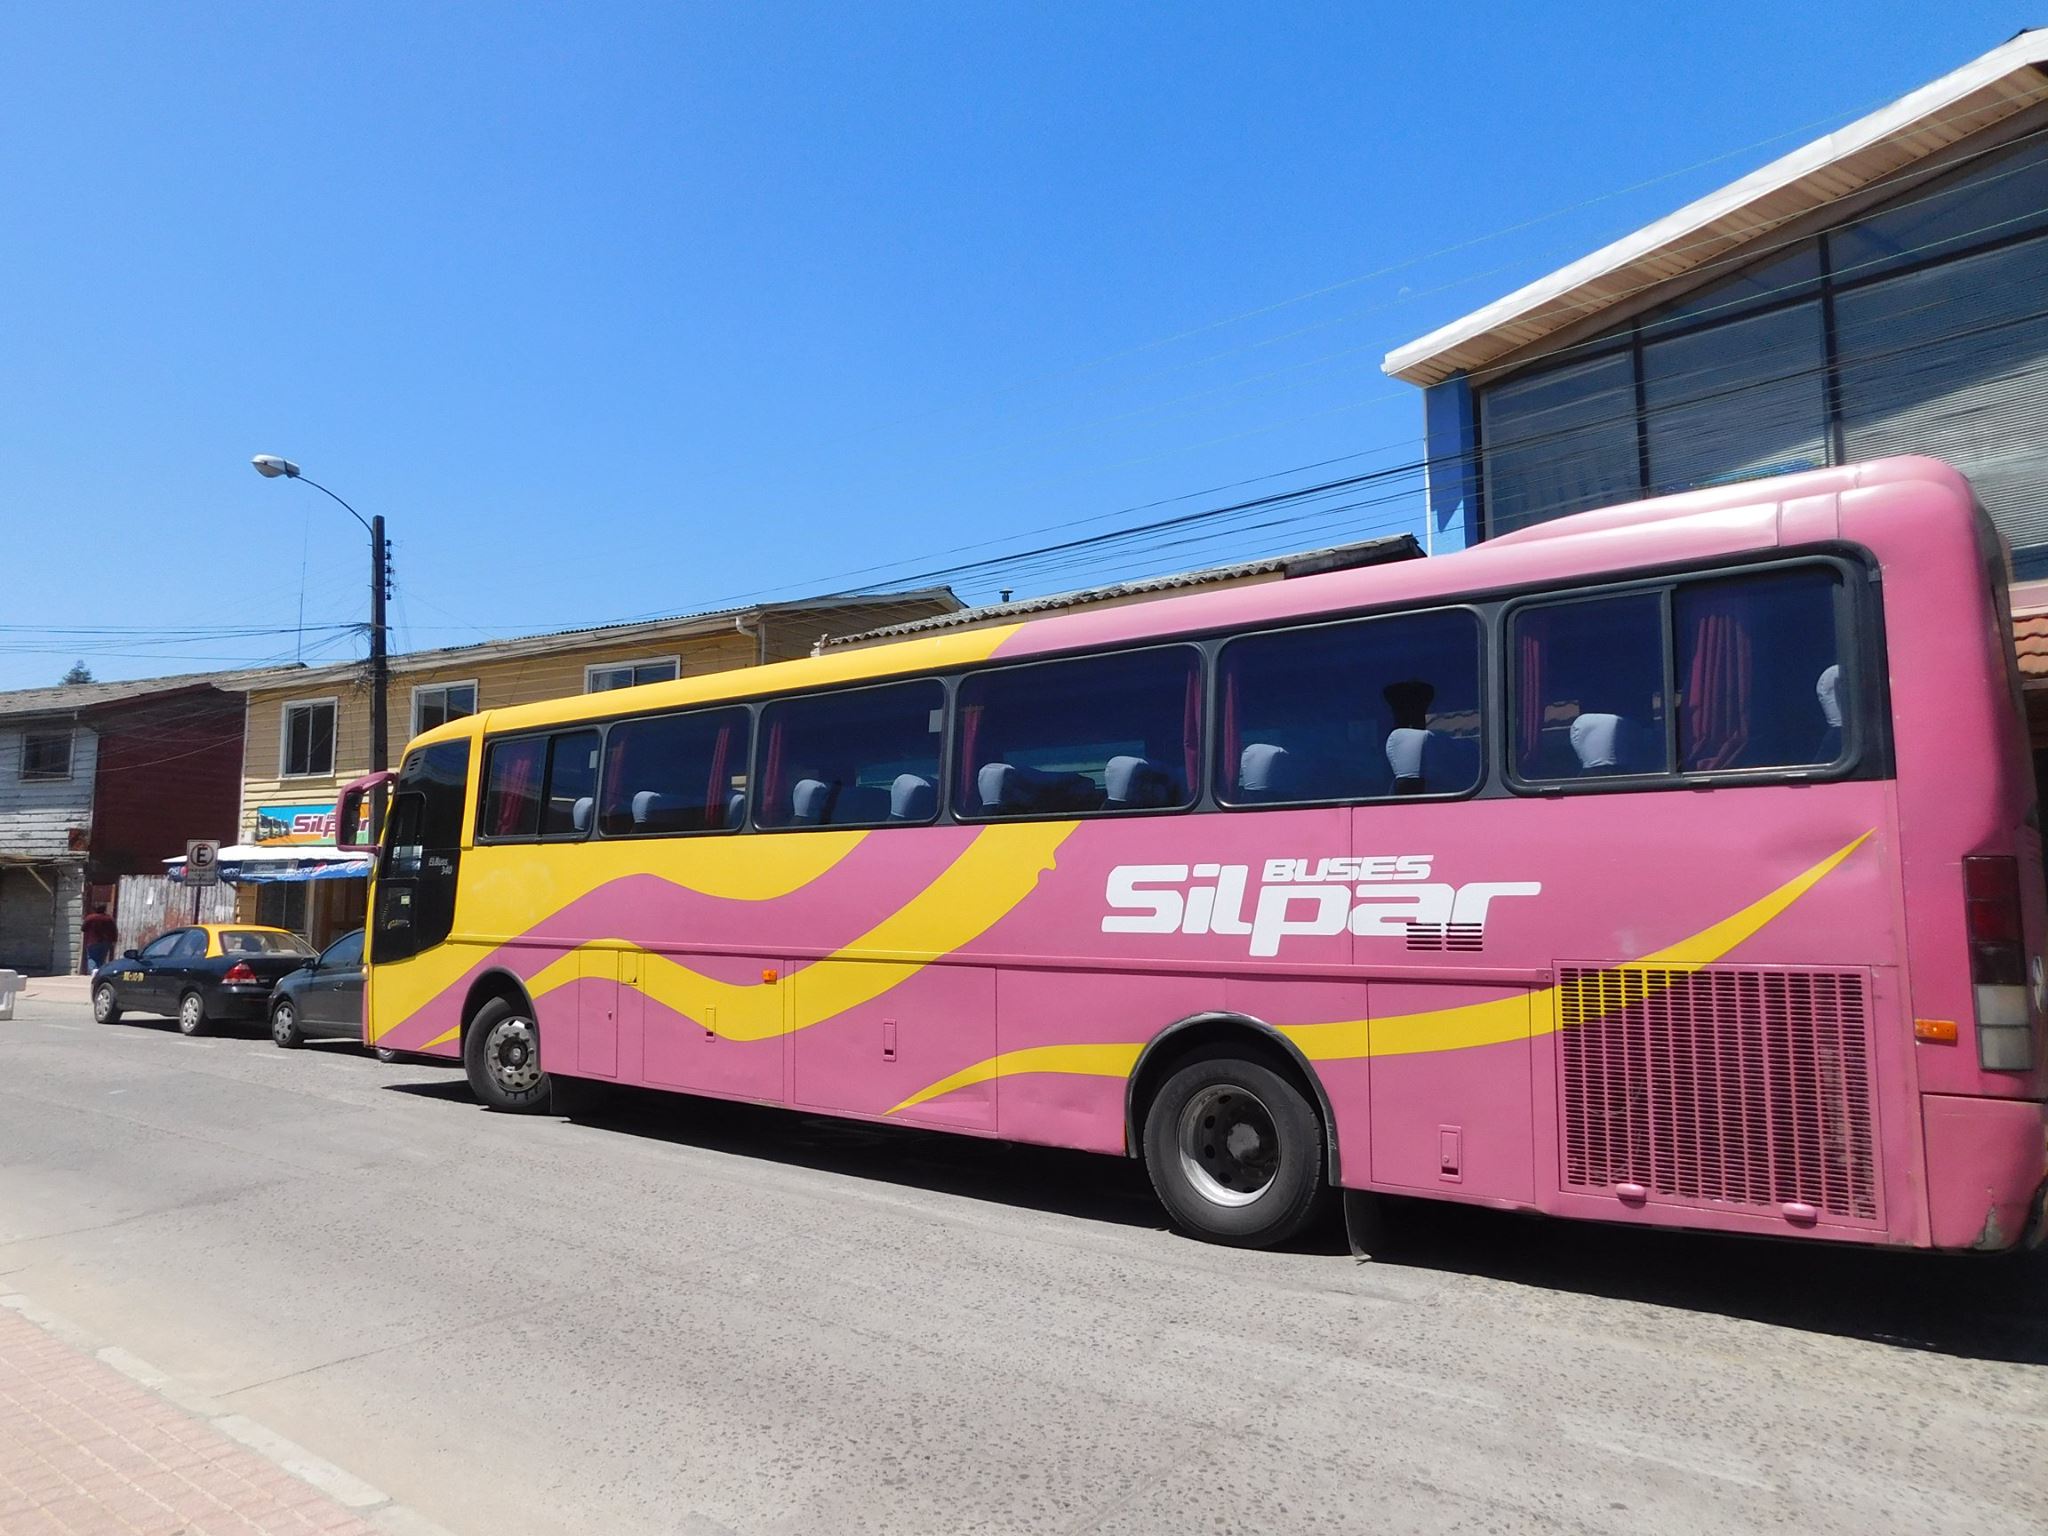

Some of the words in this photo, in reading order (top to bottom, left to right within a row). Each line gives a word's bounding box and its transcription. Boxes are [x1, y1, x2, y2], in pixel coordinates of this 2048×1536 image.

[292, 815, 369, 837] Silpr
[197, 847, 208, 863] E
[1262, 854, 1434, 882] BUSES
[1101, 863, 1542, 956] Silpar
